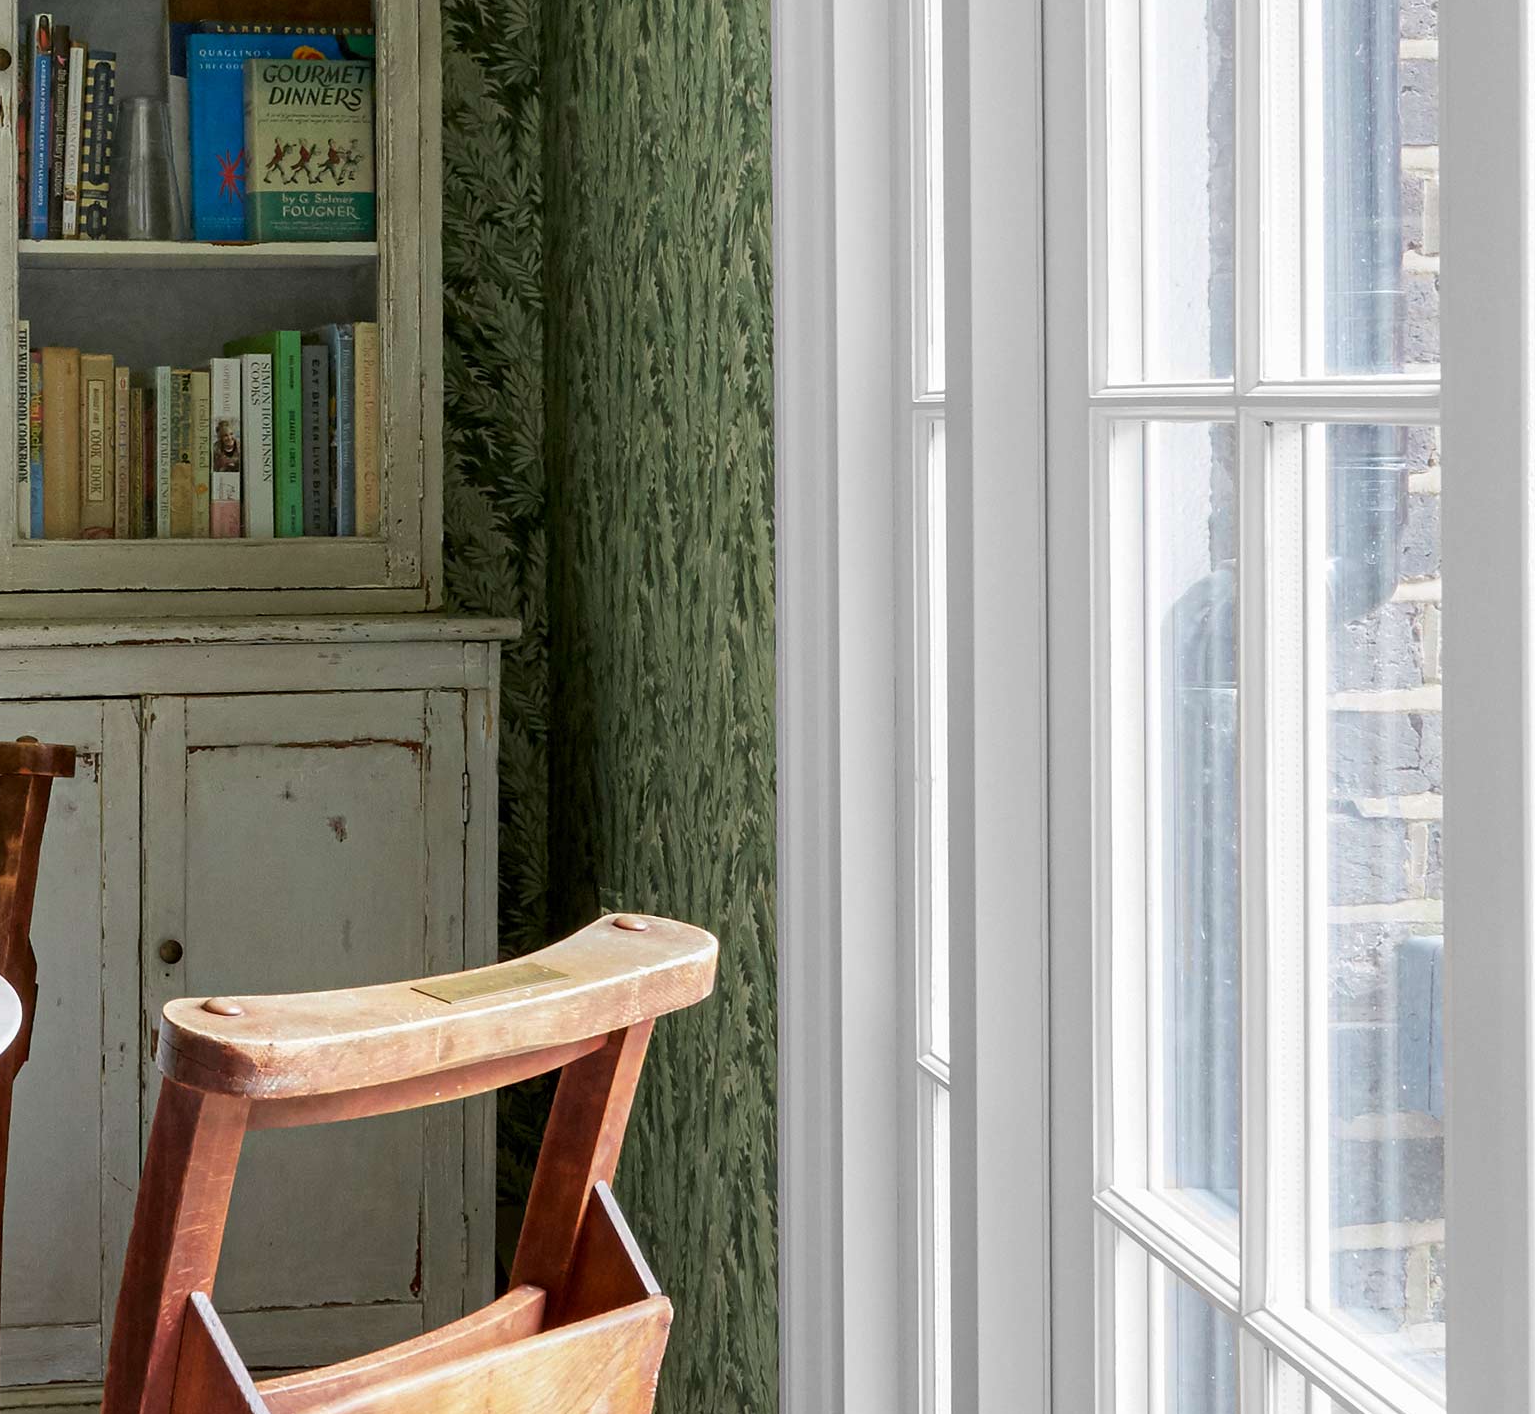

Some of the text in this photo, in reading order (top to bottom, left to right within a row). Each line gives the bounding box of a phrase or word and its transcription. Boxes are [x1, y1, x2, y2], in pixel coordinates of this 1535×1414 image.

[217, 24, 273, 34] LARRY
[199, 48, 272, 58] QUAGLINO'S
[263, 64, 372, 87] GOURMET
[268, 87, 364, 112] DINNERS
[53, 69, 67, 197] the hummingbird bakery cookbook
[67, 143, 77, 183] COOKING
[281, 193, 355, 205] by Selmer
[282, 206, 361, 220] FOUGNER
[250, 361, 261, 406] COOKS
[17, 329, 29, 484] THE WHOLEFOOD COOKBOOK
[182, 373, 191, 464] The of
[260, 362, 272, 482] SIMON HOPKINSON
[288, 410, 296, 444] BREAKFAST
[198, 397, 209, 469] Freshly Picked
[311, 359, 321, 530] EAT BETTER LIVE BETTER
[90, 429, 102, 494] COOK BOOK
[160, 417, 169, 520] COCKTAILS PUNCHES
